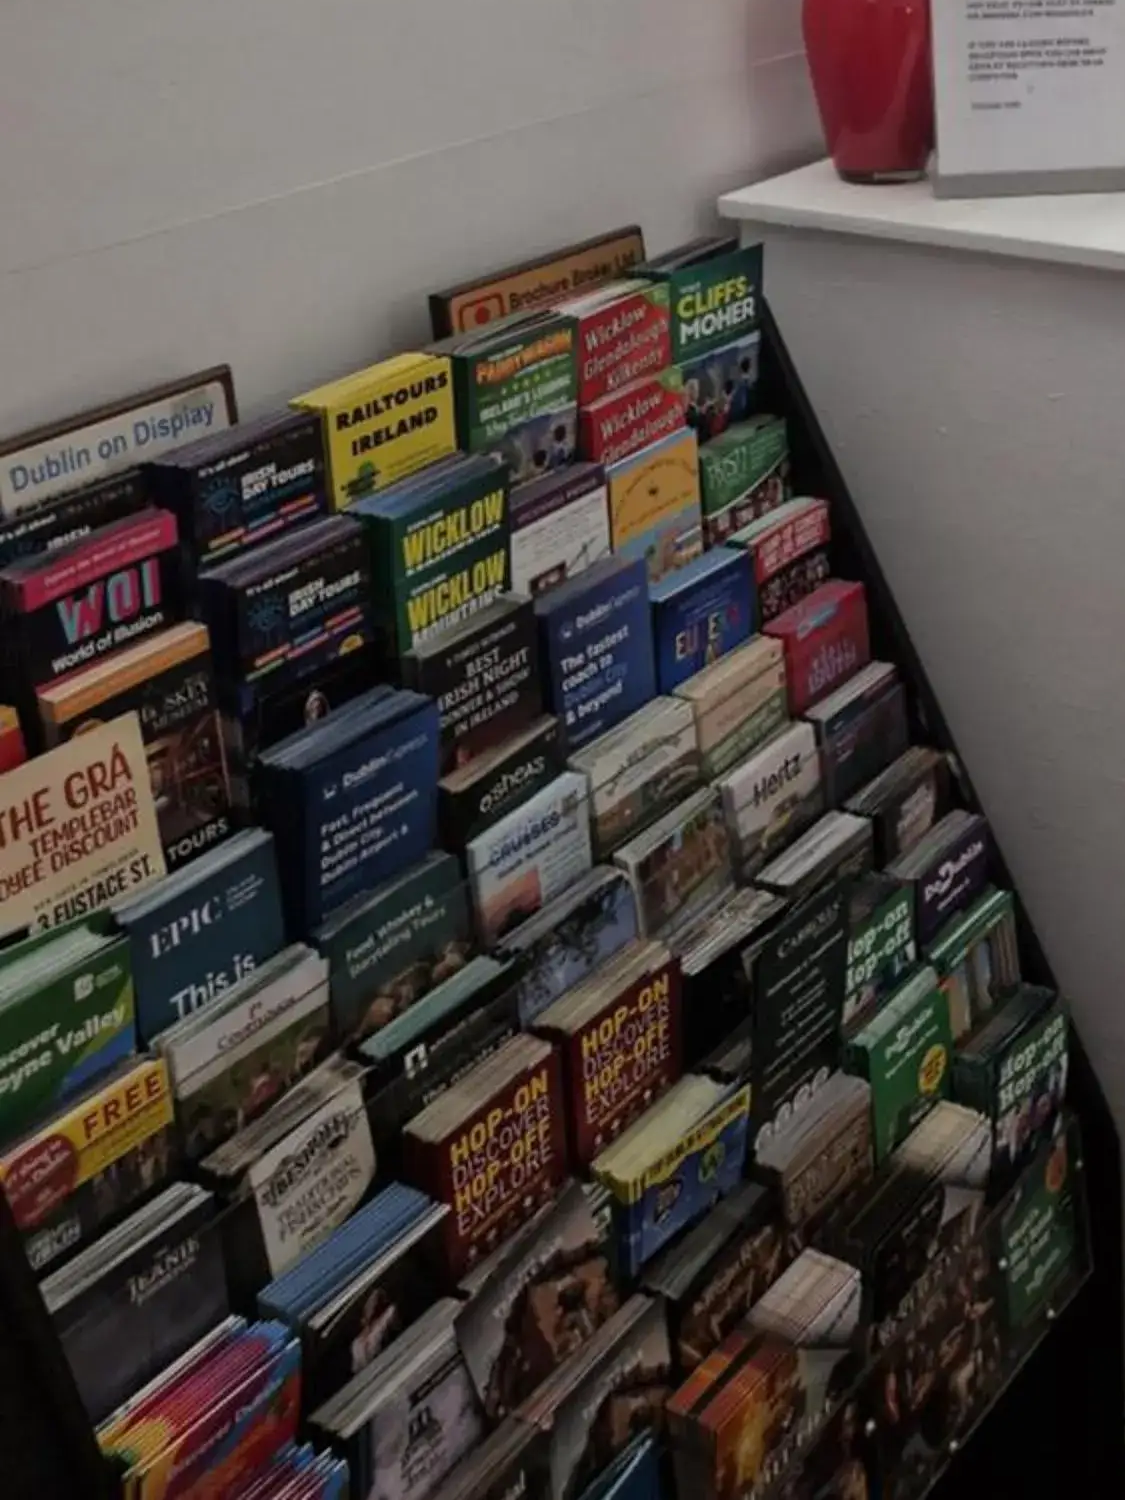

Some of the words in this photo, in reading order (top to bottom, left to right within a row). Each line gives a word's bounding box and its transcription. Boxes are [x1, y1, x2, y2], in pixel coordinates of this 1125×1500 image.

[585, 304, 647, 351] Wicklow
[677, 276, 747, 318] CLIFFS
[680, 296, 754, 344] MOHER
[336, 371, 447, 431] RAILTOURS
[352, 407, 438, 456] IRELAND
[9, 448, 91, 492] Dublin
[98, 433, 128, 459] on
[133, 402, 215, 447] Display
[404, 488, 504, 566] WICKLOW
[408, 548, 506, 632] WICKLOW
[96, 631, 112, 651] of
[483, 647, 529, 686] NIGHT
[752, 752, 802, 807] Hertz
[0, 786, 55, 849] THE
[28, 787, 137, 858] TEMPLEBAR
[167, 818, 229, 861] TOURS
[0, 860, 46, 902] OYEE
[53, 869, 129, 925] EUSTACE
[150, 896, 223, 959] EPIC
[169, 971, 229, 1019] This
[232, 953, 255, 980] is
[582, 972, 669, 1058] HOP-ON
[0, 1022, 61, 1071] scover
[0, 1050, 53, 1094] oyne
[56, 1004, 125, 1054] Valley
[585, 1015, 670, 1102] HOP-OFF
[82, 1071, 161, 1140] FREE
[586, 1043, 671, 1124] EXPLORE
[450, 1068, 548, 1167] HOP-ON
[452, 1094, 550, 1191] DISCOVER
[455, 1115, 552, 1212] HOP-OFF
[457, 1139, 554, 1237] EXPLORE
